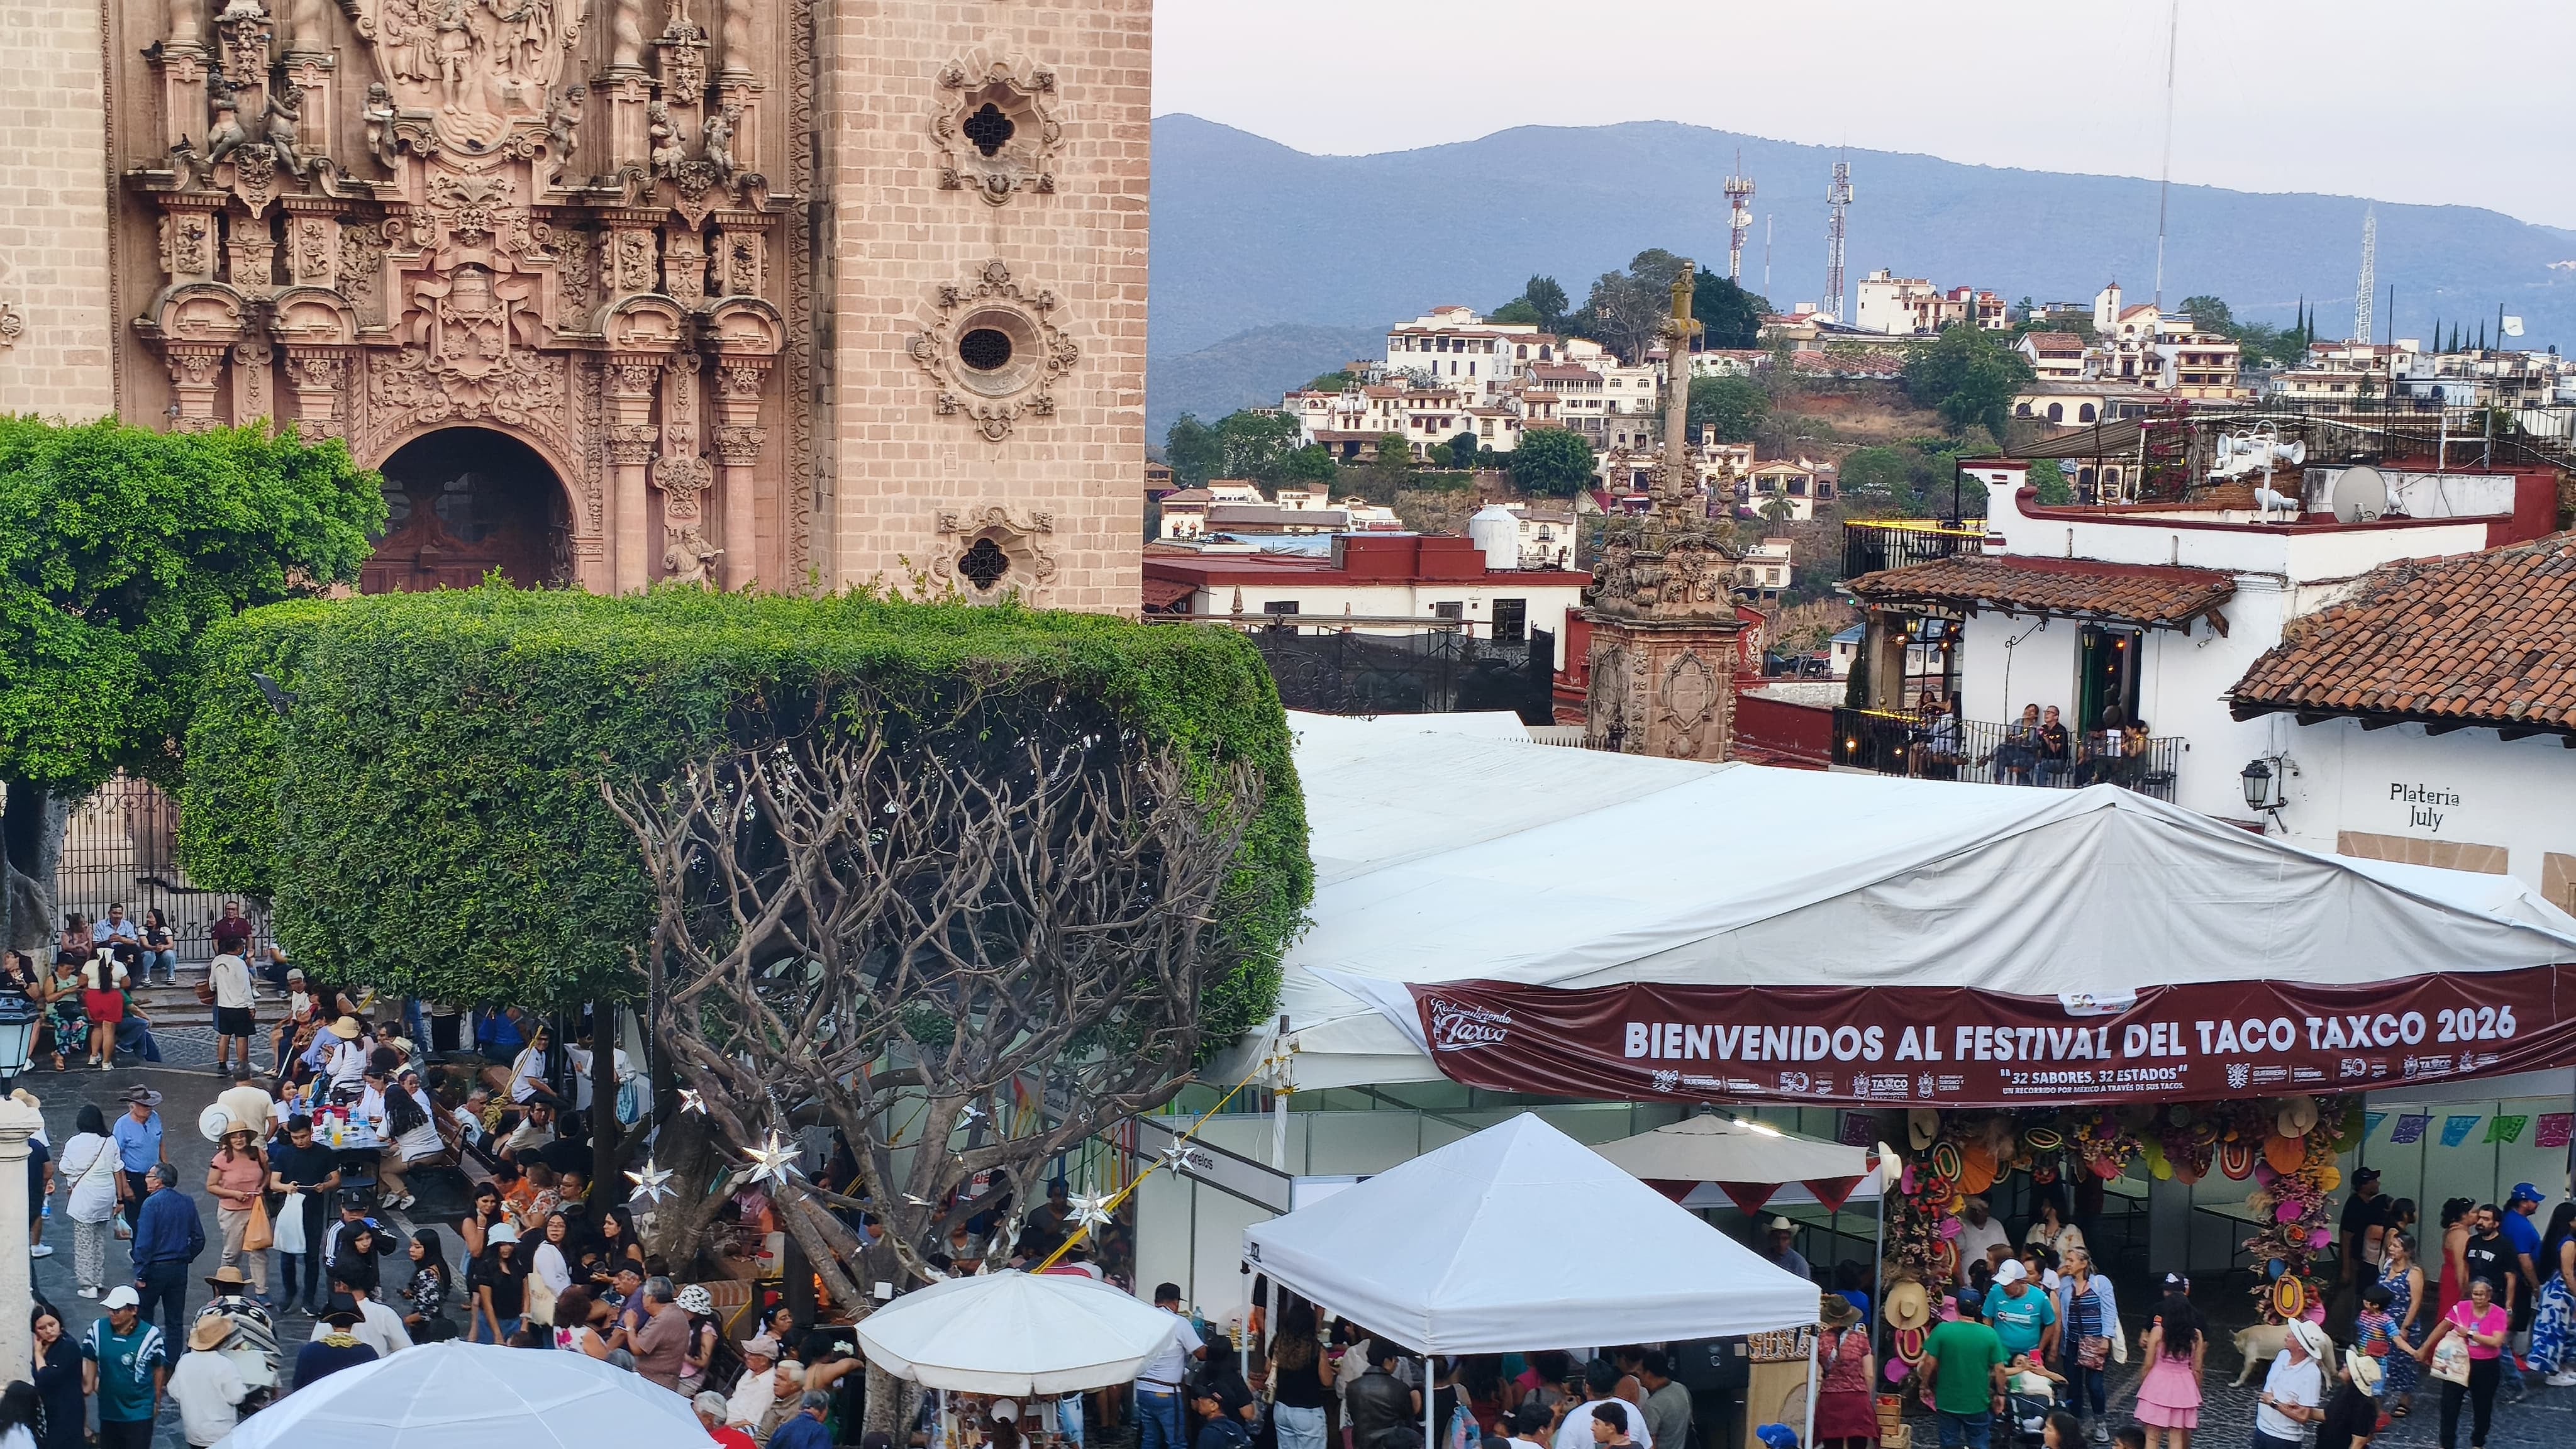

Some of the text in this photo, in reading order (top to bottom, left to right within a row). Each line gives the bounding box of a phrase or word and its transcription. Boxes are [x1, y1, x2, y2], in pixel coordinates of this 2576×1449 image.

[2390, 783, 2460, 806] Plateria
[2409, 805, 2444, 832] July
[1441, 1013, 1509, 1044] Taxco
[1624, 1005, 2516, 1062] BIENVENIDOS AL FESTIVAL DEL TACO TAXCO 2026
[2031, 1071, 2096, 1084] SABORES,
[2099, 1070, 2114, 1082] 32
[2014, 1086, 2057, 1094] RECORRIDO
[1188, 1152, 1213, 1170] orelos
